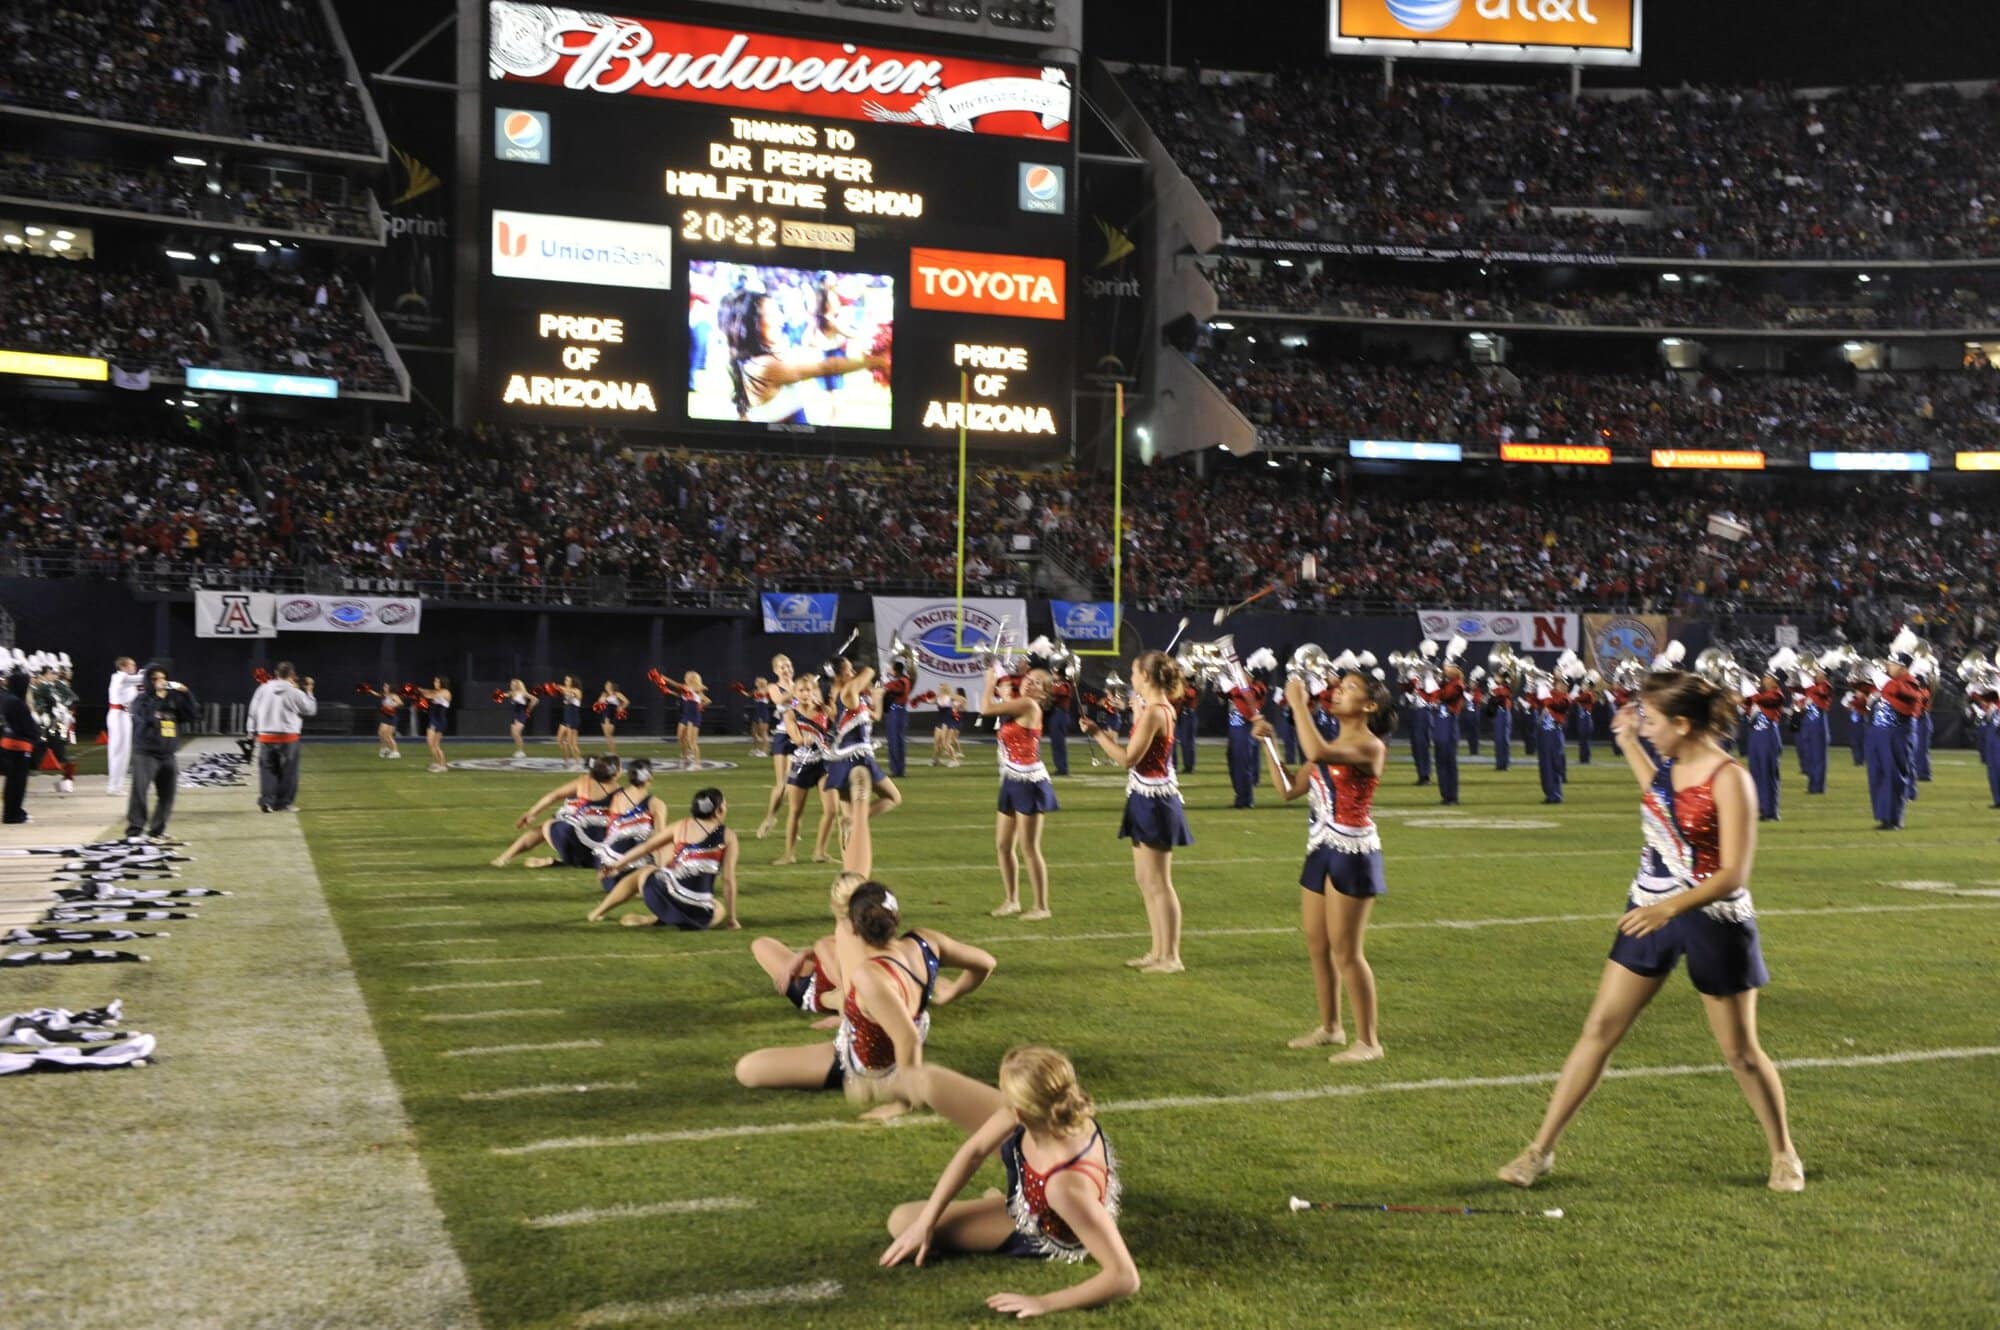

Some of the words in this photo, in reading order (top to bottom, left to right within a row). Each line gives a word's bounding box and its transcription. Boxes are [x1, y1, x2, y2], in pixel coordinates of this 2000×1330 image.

[546, 20, 944, 95] Budweiser
[730, 117, 818, 147] THANKS
[823, 127, 856, 150] TO
[710, 144, 751, 171] DR
[764, 149, 874, 184] PEPPER
[666, 170, 826, 209] HALFTIME
[844, 185, 923, 217] SHOW
[380, 210, 448, 239] Sprint
[682, 209, 777, 247] 20:22
[918, 264, 1058, 306] TOYOTA
[540, 314, 623, 343] PRIDE
[562, 347, 600, 371] OF
[954, 344, 1027, 371] PRIDE
[503, 376, 657, 412] ARIZONA
[974, 374, 1008, 396] OF
[922, 402, 1056, 434] ARIZONA
[1503, 446, 1554, 458] WELLS
[1557, 448, 1608, 461] FARGO
[216, 595, 259, 634] A
[964, 610, 993, 631] LIFE
[1533, 616, 1566, 648] N
